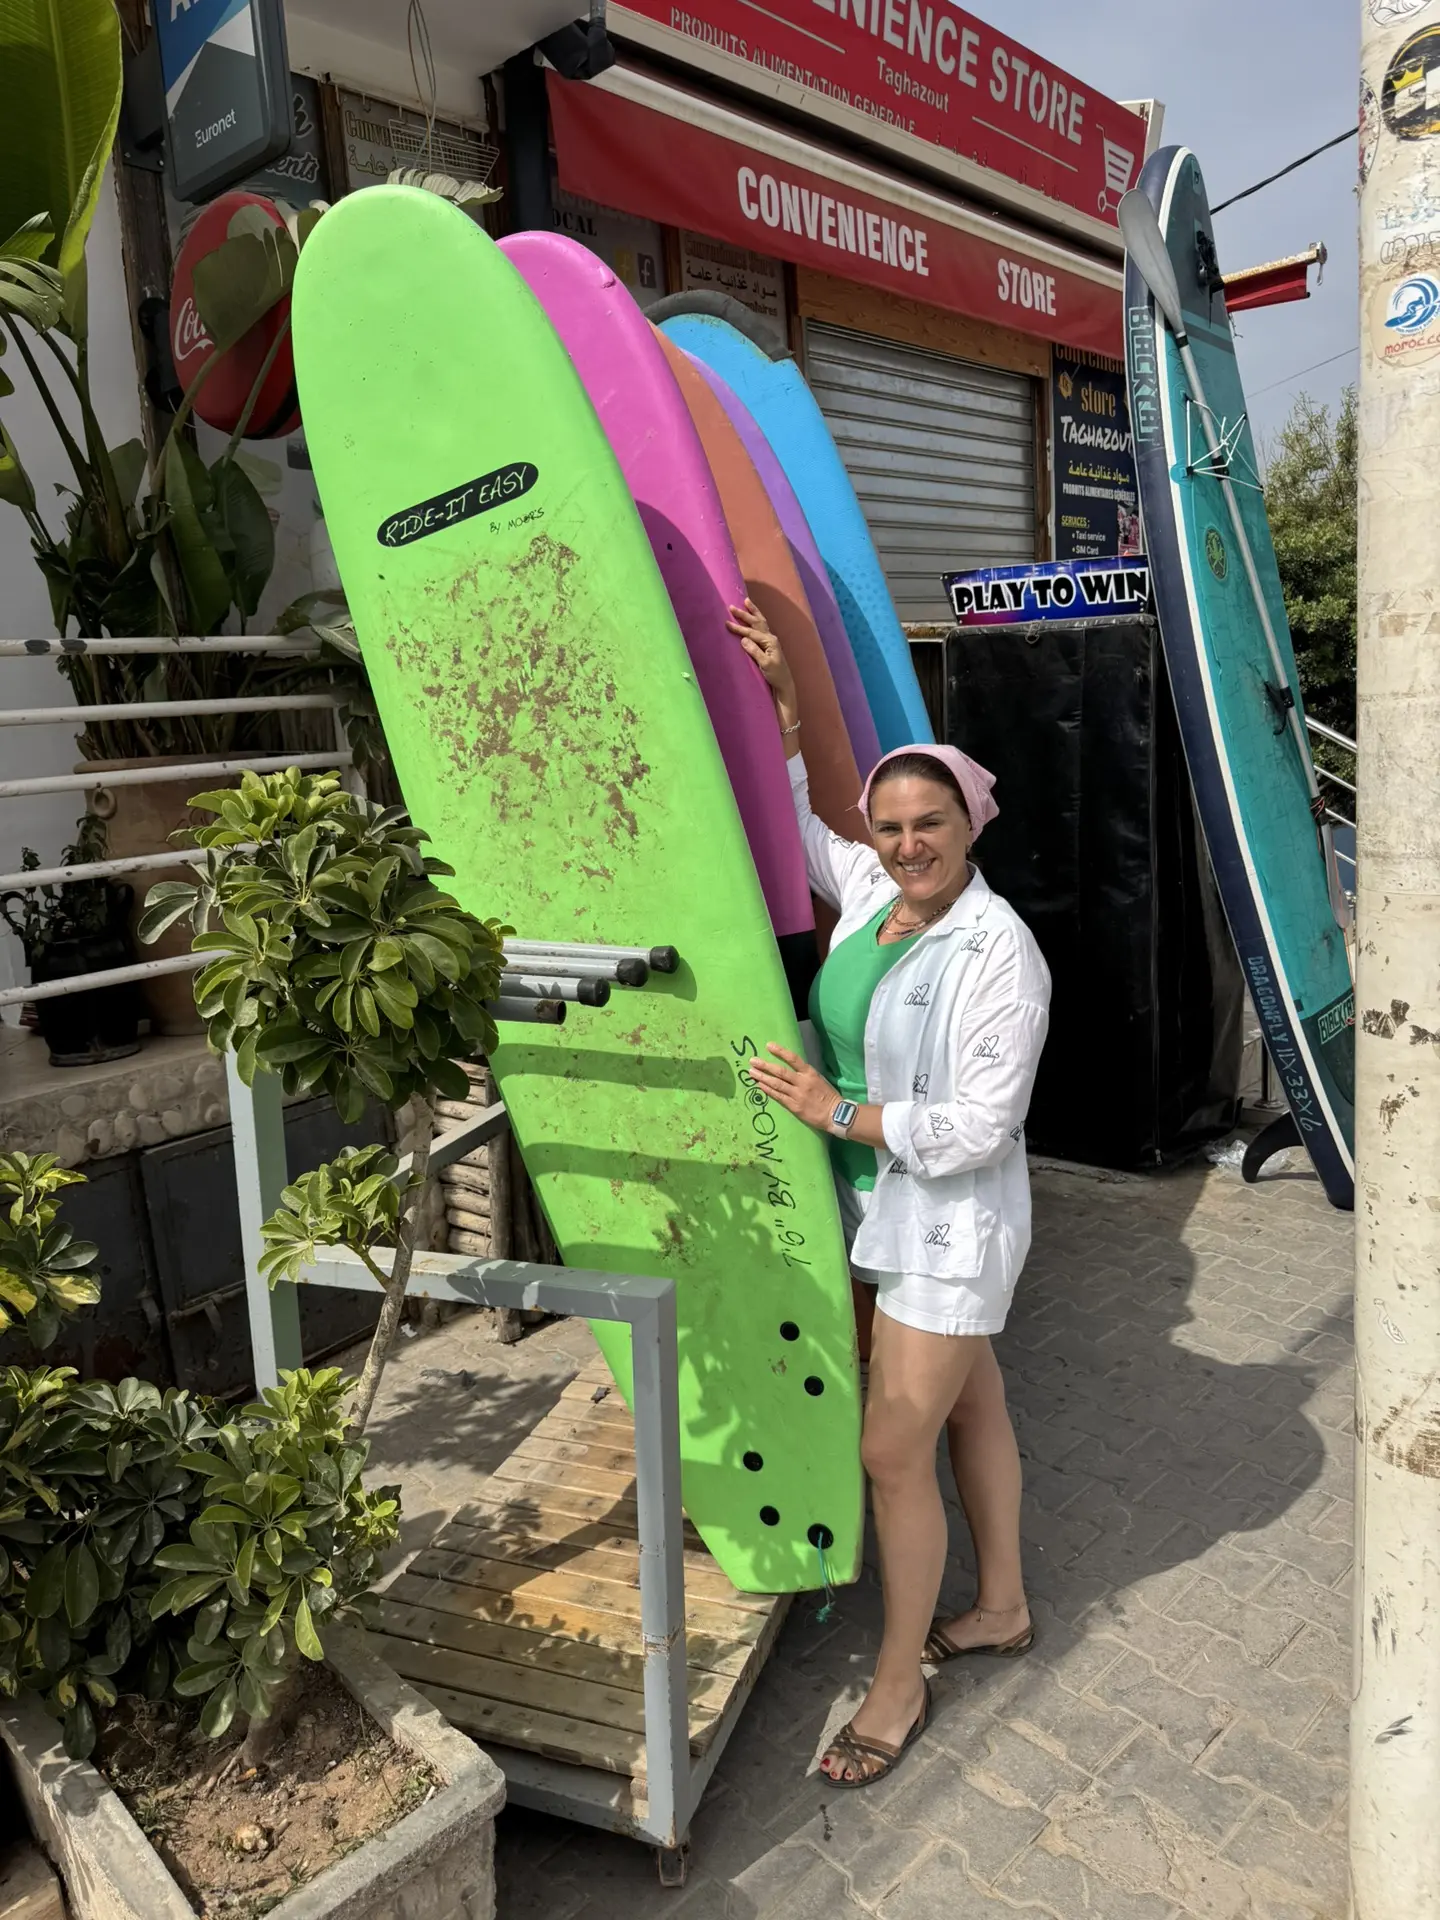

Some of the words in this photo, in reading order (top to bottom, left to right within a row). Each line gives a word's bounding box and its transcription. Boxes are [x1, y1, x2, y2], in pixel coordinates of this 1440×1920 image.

[671, 6, 748, 60] PRODUITS
[752, 48, 851, 106] ALIMENTATION
[854, 94, 916, 134] GENERALE
[877, 56, 949, 112] Taghazout
[989, 46, 1086, 145] STORE
[194, 109, 237, 148] Euronet
[737, 166, 930, 277] CONVENIENCE
[997, 258, 1057, 316] STORE
[1081, 381, 1116, 417] store
[1060, 415, 1133, 455] TAGHAZOUT
[1068, 460, 1087, 477] عامة
[385, 489, 474, 545] RIDE-IT
[479, 465, 527, 504] EASY
[1062, 482, 1085, 497] PRODUITS
[1085, 485, 1114, 500] ALIMENTAIRES
[1075, 530, 1087, 540] Taxi
[1087, 531, 1106, 542] service
[1075, 545, 1086, 555] SIM
[1086, 546, 1099, 556] Card
[951, 577, 1028, 615] PLAY
[1029, 573, 1077, 609] TO
[1075, 567, 1150, 605] WIN
[1248, 956, 1289, 1043] DRAGONFLY
[762, 1171, 797, 1210] BY
